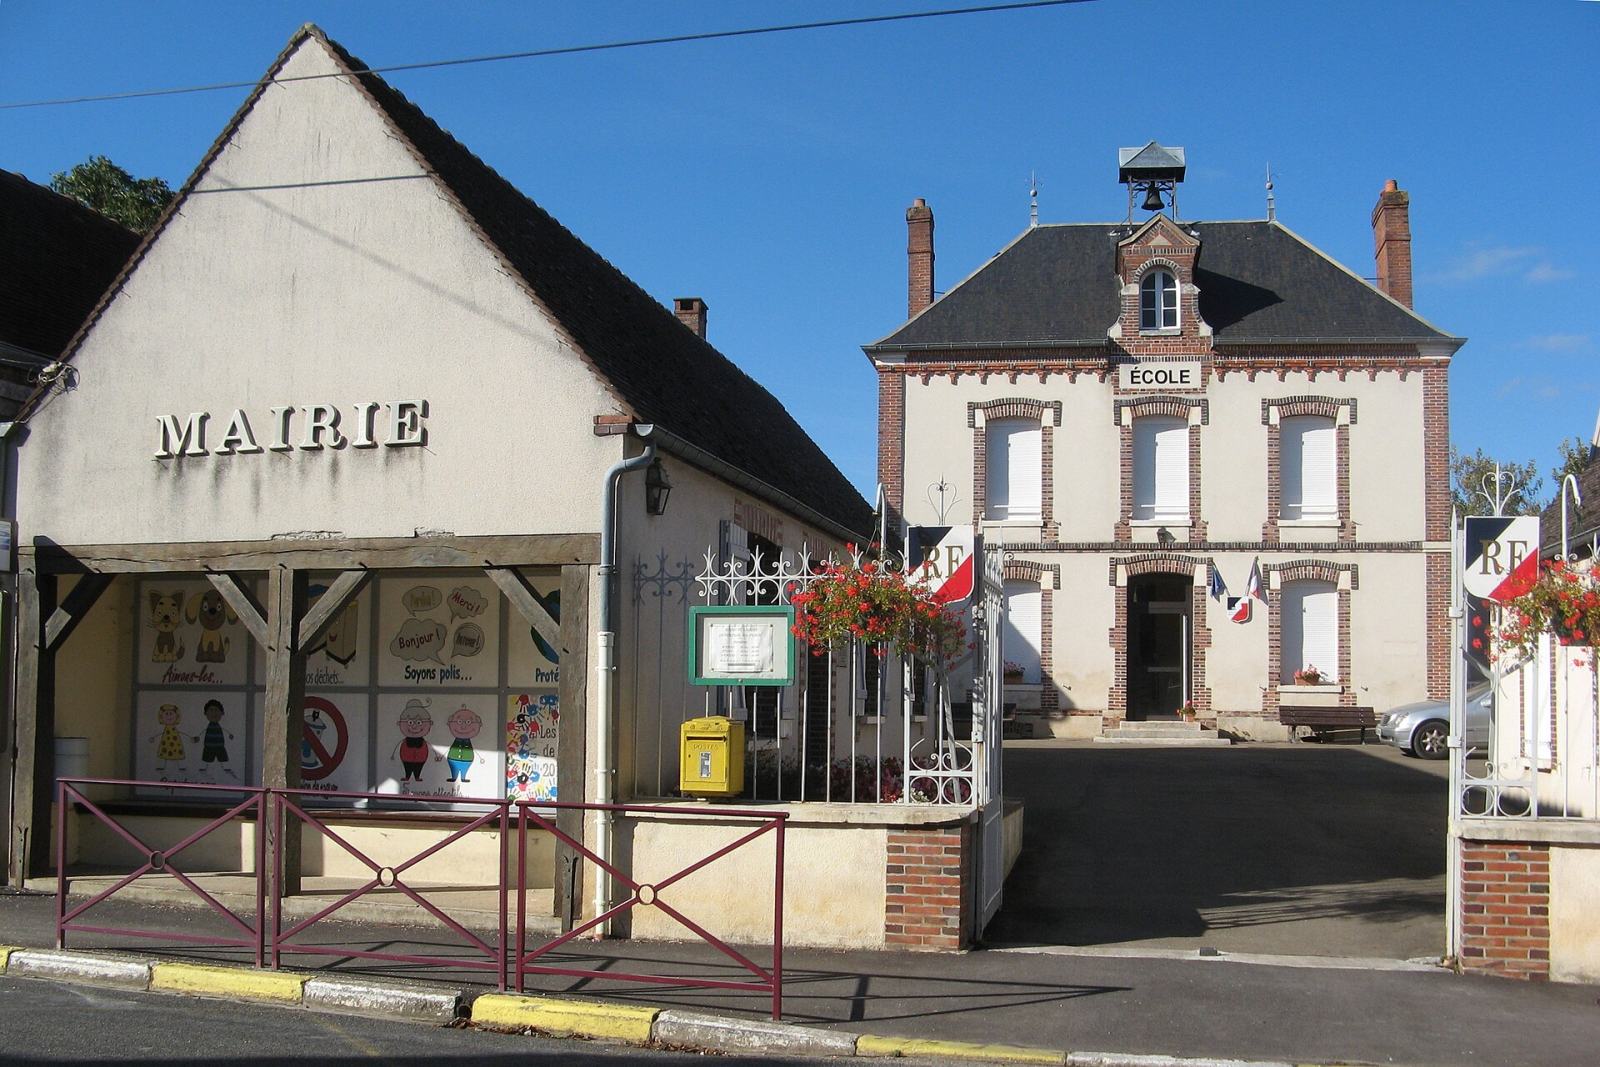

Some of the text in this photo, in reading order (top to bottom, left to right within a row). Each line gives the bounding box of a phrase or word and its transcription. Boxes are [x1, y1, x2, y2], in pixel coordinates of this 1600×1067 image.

[1130, 366, 1190, 384] ÉCOLE
[154, 399, 429, 459] MAIRIE
[921, 545, 963, 581] RF
[1479, 540, 1527, 575] RF
[398, 632, 434, 649] Bonjour
[404, 664, 472, 684] Soyons polis...
[535, 667, 559, 682] Proté
[540, 725, 556, 739] Les
[543, 747, 555, 758] de
